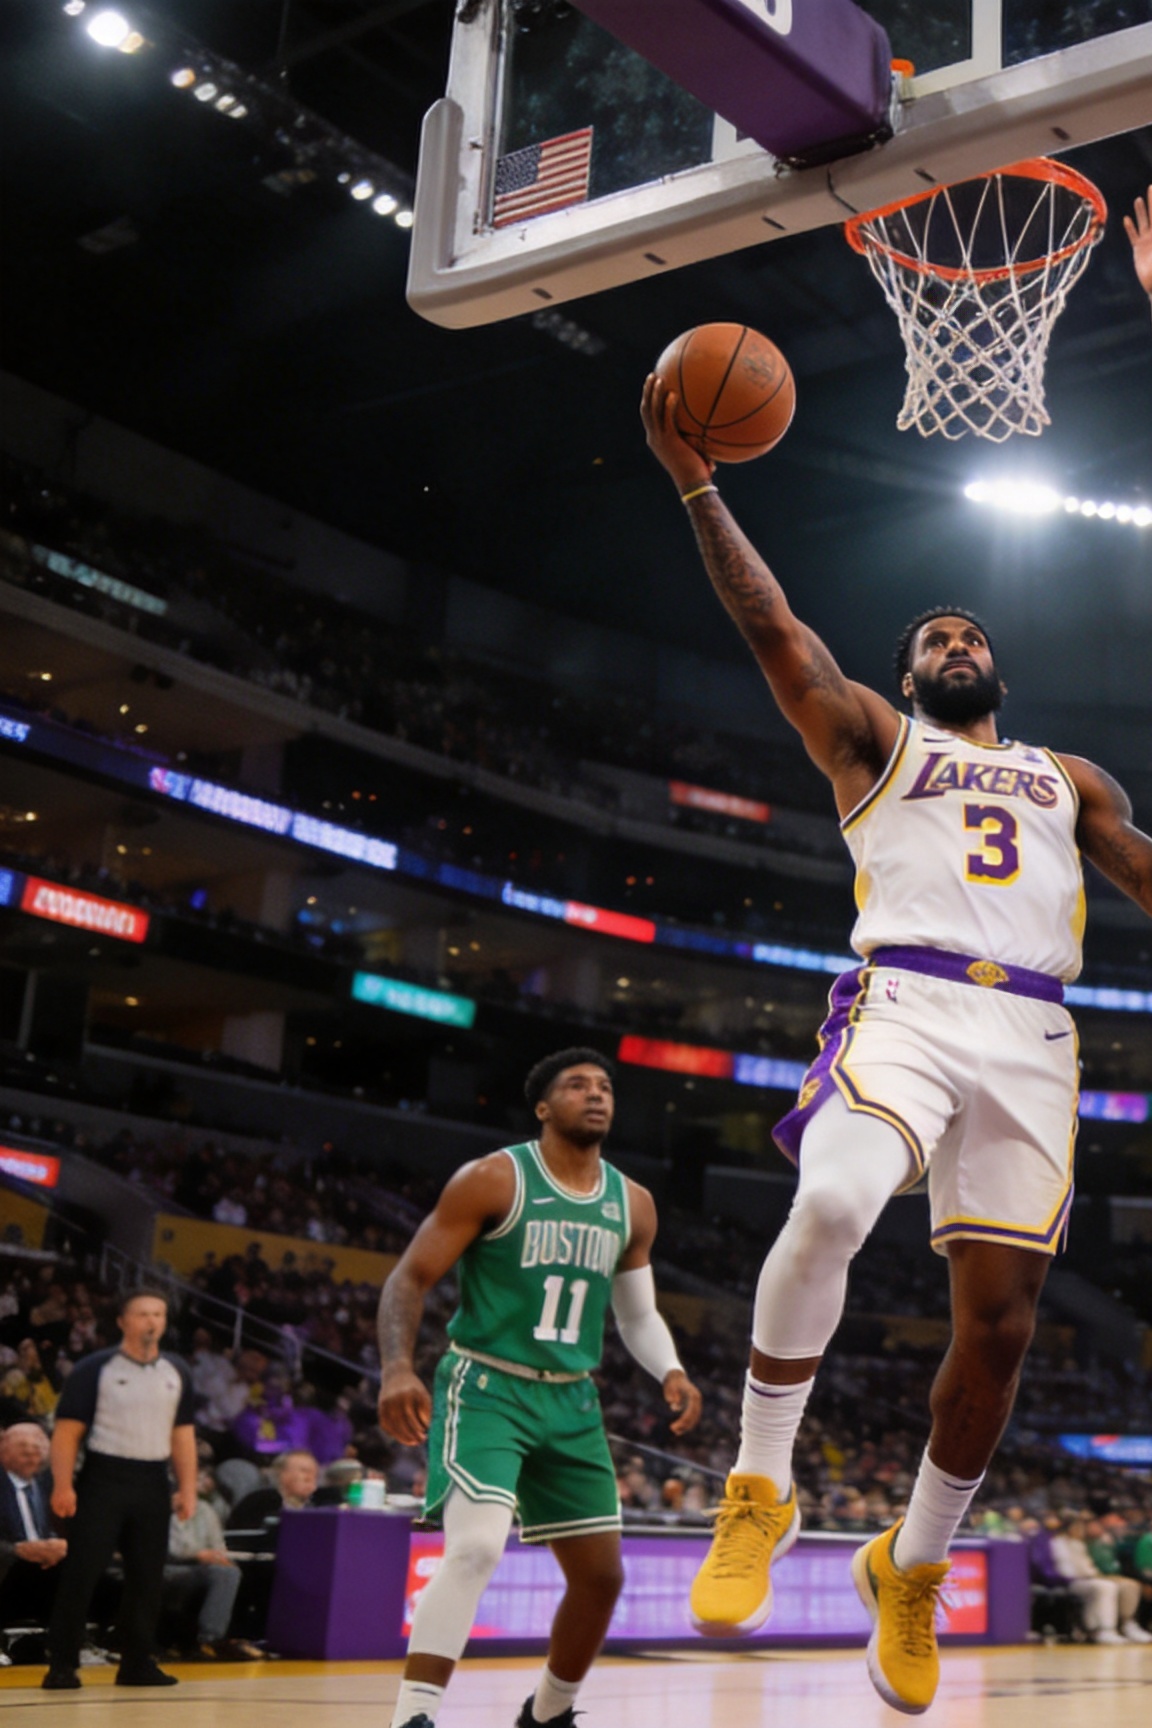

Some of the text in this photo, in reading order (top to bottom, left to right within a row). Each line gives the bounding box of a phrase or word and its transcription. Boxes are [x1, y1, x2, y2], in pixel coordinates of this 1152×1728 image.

[901, 752, 1059, 810] LAKERS
[963, 802, 1022, 887] 3
[533, 1275, 589, 1344] 11
